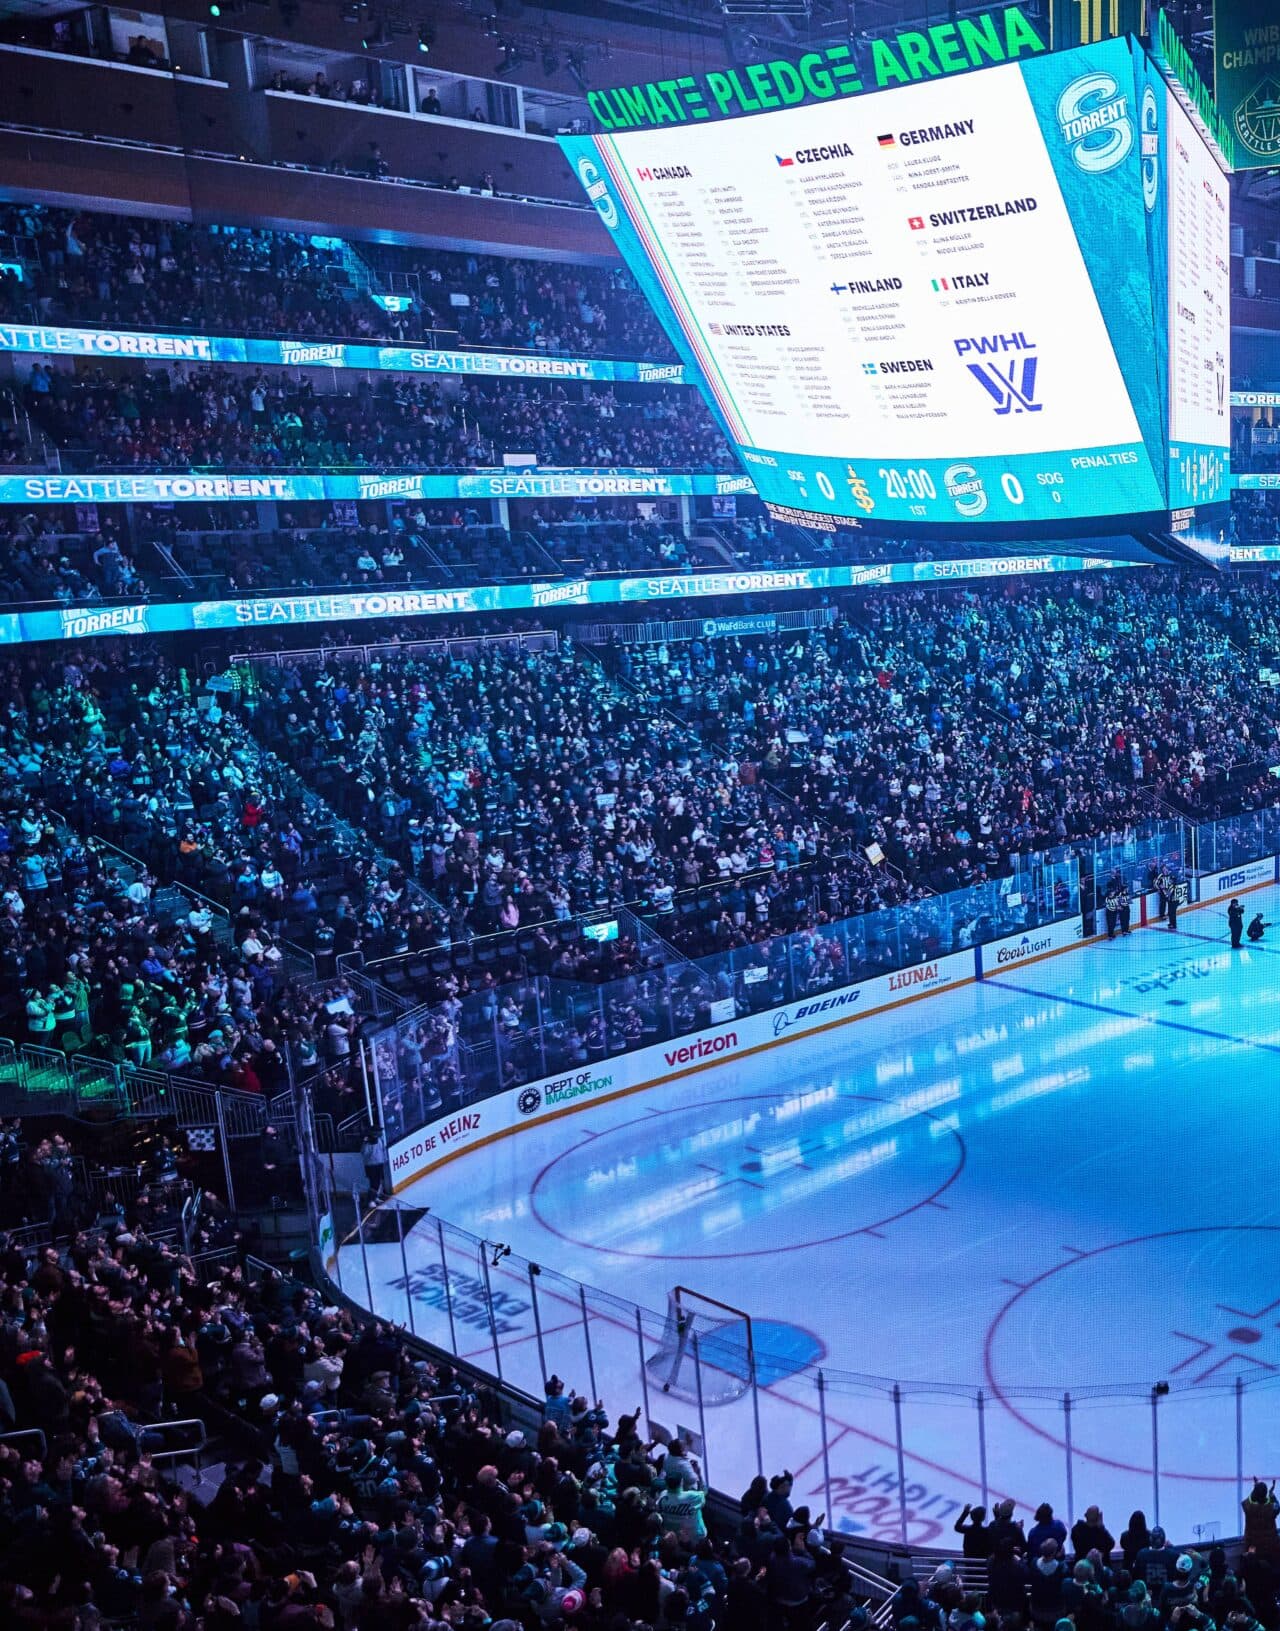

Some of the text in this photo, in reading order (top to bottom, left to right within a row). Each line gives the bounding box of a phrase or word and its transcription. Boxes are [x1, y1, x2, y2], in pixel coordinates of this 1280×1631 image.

[587, 76, 710, 130] CLIMATE
[705, 45, 864, 115] PLEDGE
[871, 6, 1046, 87] ARENA
[1062, 97, 1128, 141] TORRENT
[899, 119, 975, 147] GERMANY
[1238, 113, 1273, 152] SEATTLE
[795, 142, 855, 164] CZECHIA
[652, 165, 693, 180] CANADA
[929, 197, 1038, 227] SWITZERLAND
[848, 277, 903, 295] FINLAND
[952, 272, 990, 290] ITALY
[722, 324, 791, 337] UNITED STATES
[77, 333, 210, 357] TORRENT
[281, 343, 345, 364] TORRENT
[953, 331, 1037, 356] PWHL
[410, 353, 588, 376] SEATTLE TORRENT
[639, 365, 684, 382] TORRENT
[879, 359, 934, 374] SWEDEN
[1071, 451, 1138, 469] PENALTIES
[25, 479, 287, 499] SEATTLE TORRENT
[360, 476, 423, 500] TORRENT
[490, 478, 667, 494] SEATTLE TORRENT
[815, 471, 835, 501] 0
[879, 468, 936, 500] 20:00
[948, 479, 983, 496] TORRENT
[1000, 472, 1024, 505] 0
[1036, 472, 1064, 485] SOG
[1052, 491, 1061, 503] 0
[909, 505, 927, 516] 1ST
[852, 563, 892, 585] TORRENT
[934, 558, 1051, 577] SEATTLE TORRENT
[533, 581, 589, 606] TORRENT
[648, 571, 808, 595] SEATTLE TORRENT
[236, 590, 470, 623] SEATTLE TORRENT
[64, 605, 147, 635] TORRENT
[756, 620, 777, 629] CLUB
[1219, 870, 1245, 891] MPS
[1027, 938, 1052, 954] LIGHT
[889, 963, 938, 991] LiUNA!
[794, 990, 861, 1020] BOEING
[664, 1032, 738, 1067] verizon
[544, 1072, 591, 1095] DEPT OF
[545, 1076, 613, 1105] IMAGINATION
[392, 1151, 410, 1171] HAS
[410, 1144, 423, 1159] TO
[425, 1136, 437, 1152] BE
[439, 1113, 481, 1143] HEINZ
[850, 1465, 962, 1519] LIGHT
